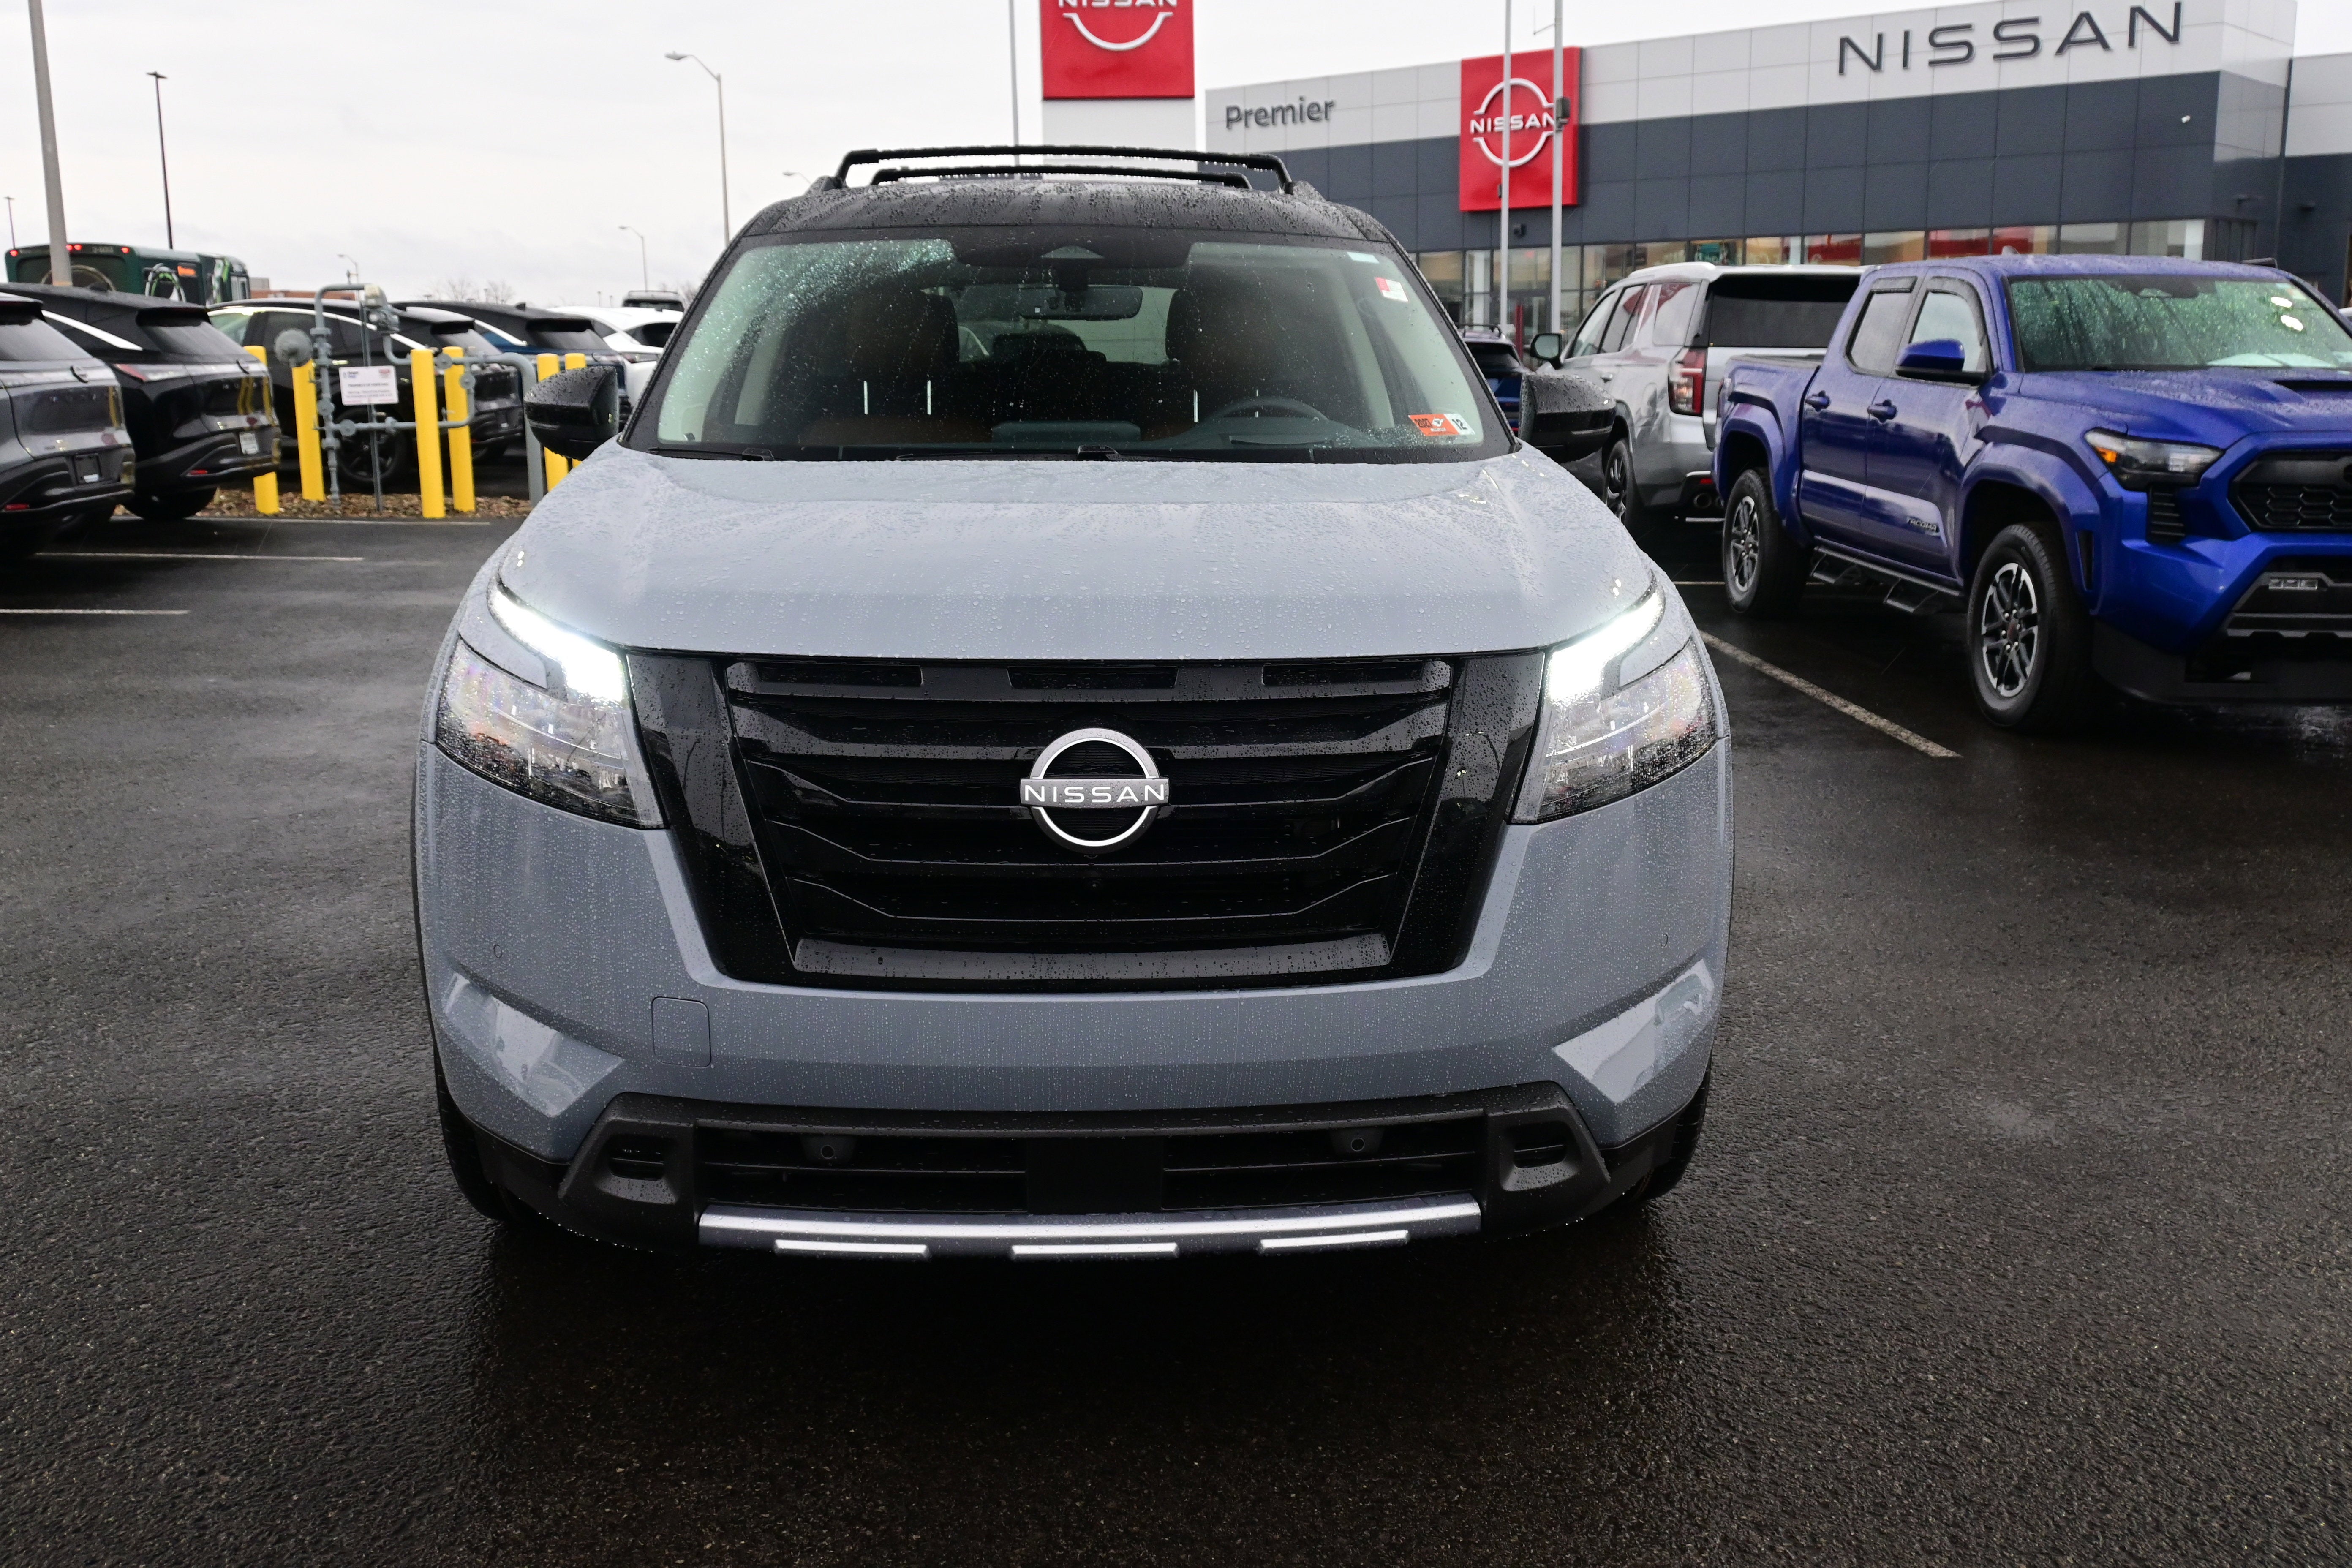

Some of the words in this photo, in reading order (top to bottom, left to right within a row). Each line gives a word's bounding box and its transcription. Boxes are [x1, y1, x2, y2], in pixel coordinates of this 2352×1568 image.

[1839, 1, 2183, 75] NISSAN
[1225, 96, 1335, 129] Premier
[1451, 419, 1467, 430] 12
[1907, 517, 1937, 531] TACOMA
[1025, 784, 1164, 803] NISSAN
